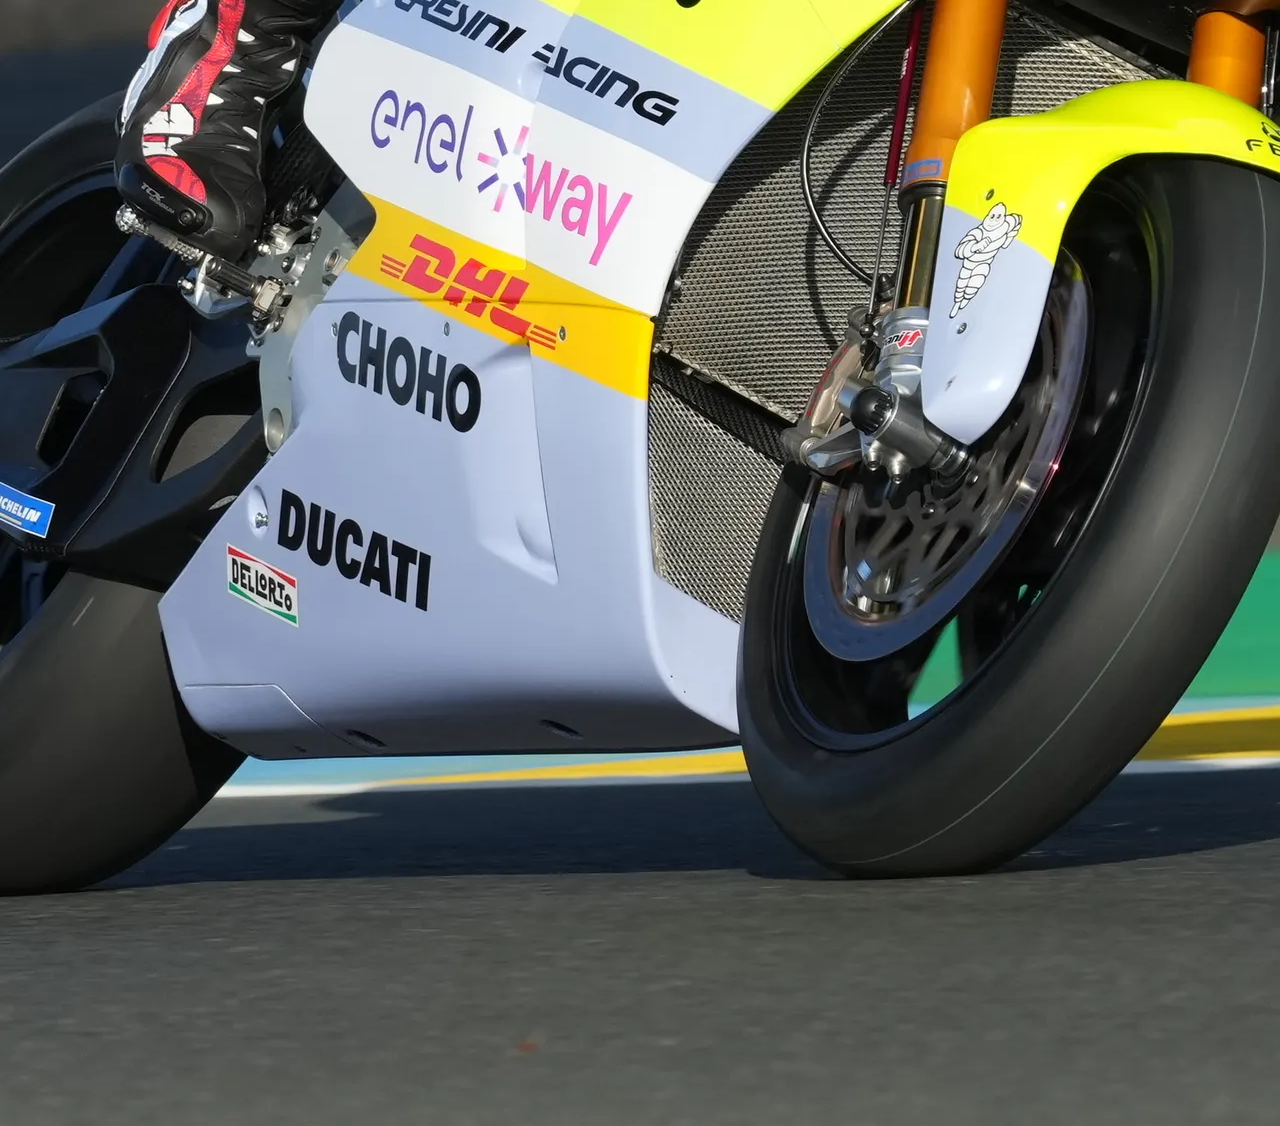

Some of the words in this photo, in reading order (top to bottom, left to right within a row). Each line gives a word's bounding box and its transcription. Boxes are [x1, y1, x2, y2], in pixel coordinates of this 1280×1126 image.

[369, 88, 474, 183] enel
[518, 151, 634, 267] way
[403, 232, 542, 340] DHL
[335, 310, 482, 434] CHOHO
[231, 556, 293, 612] DELLORTO
[276, 487, 432, 613] DUCATI
